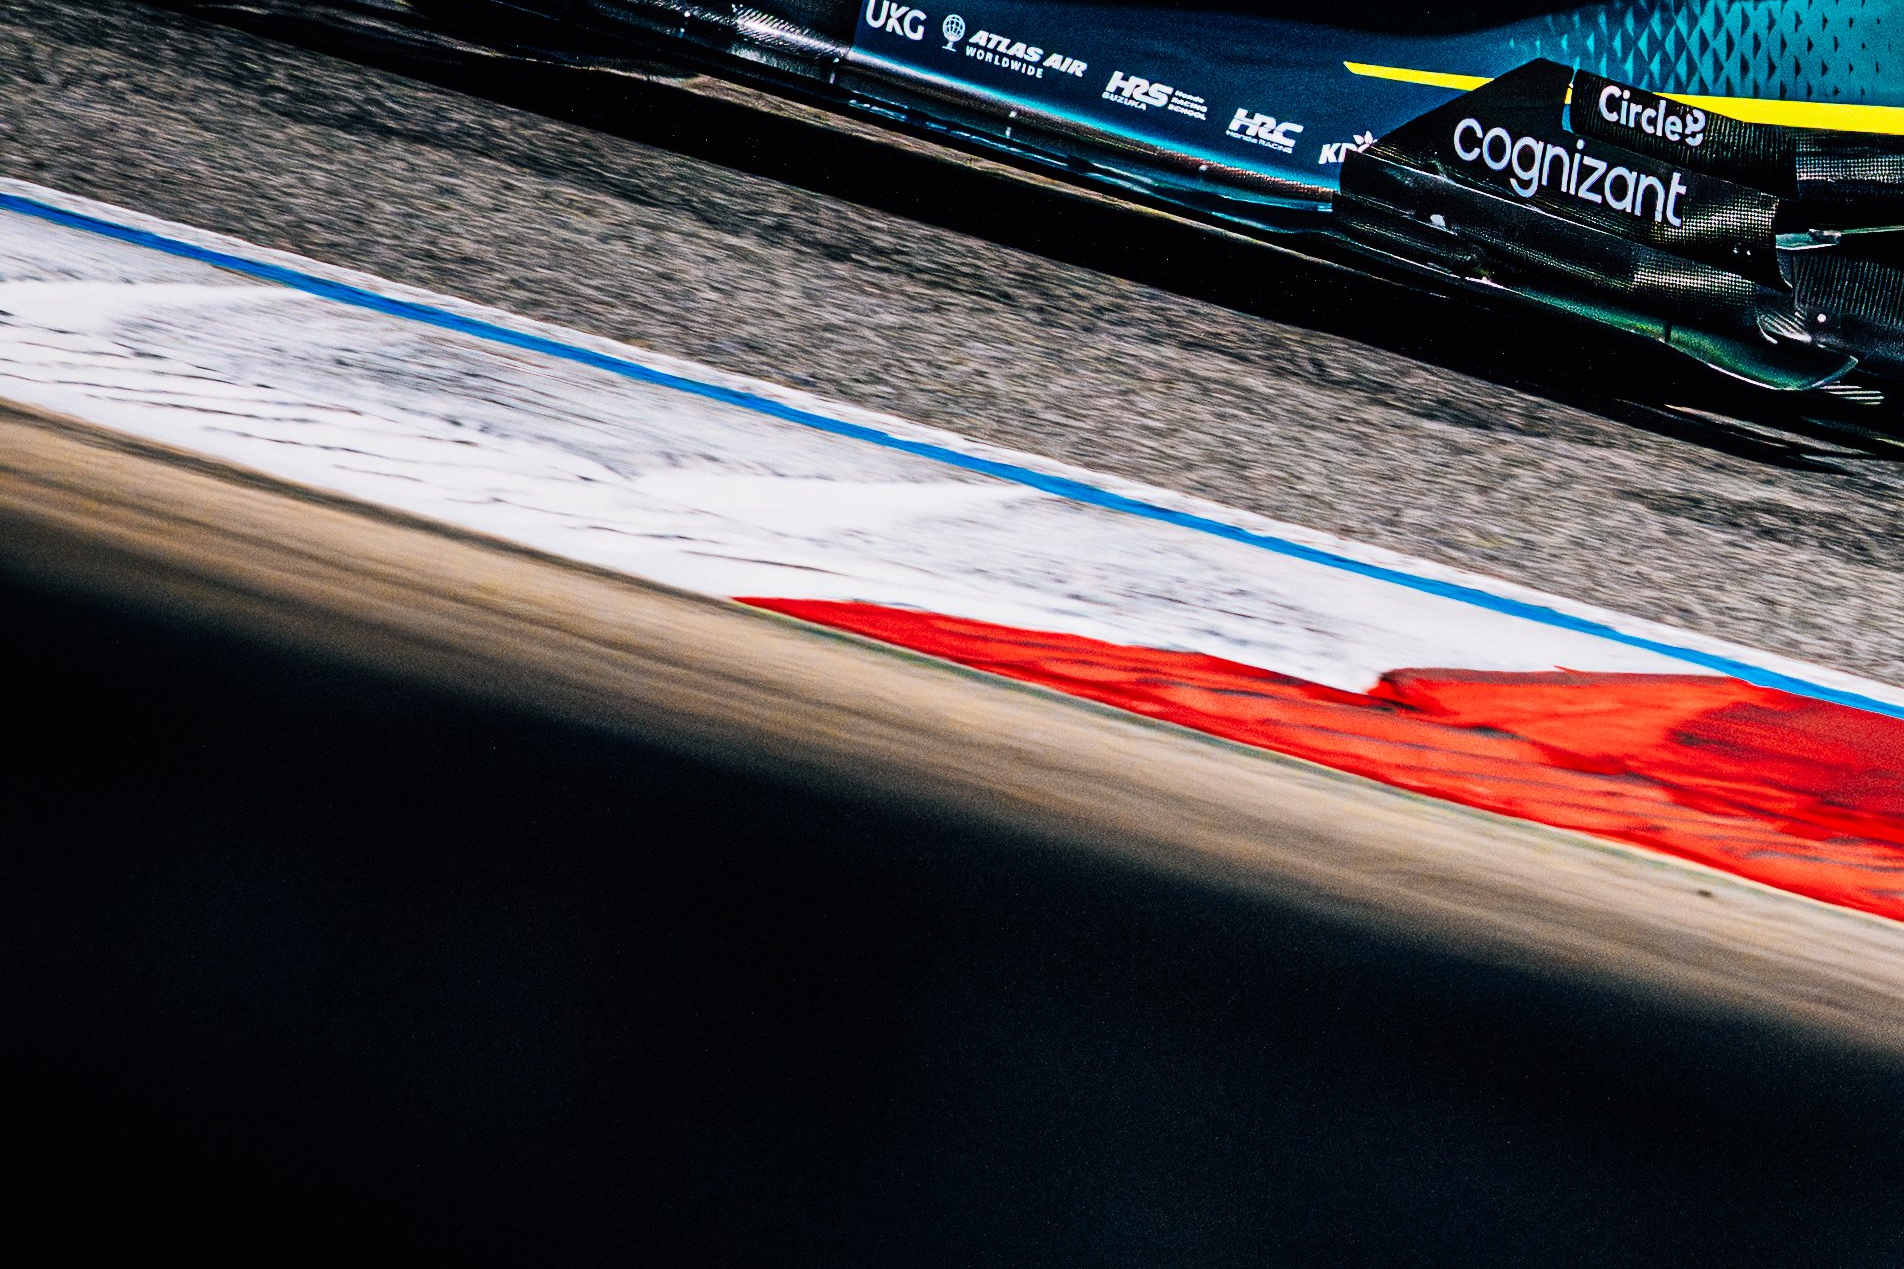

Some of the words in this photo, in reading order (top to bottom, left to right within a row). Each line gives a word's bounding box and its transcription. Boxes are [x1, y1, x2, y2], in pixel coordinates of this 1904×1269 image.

[965, 45, 1044, 79] WORLDWIDE
[969, 29, 1044, 63] ATLAS
[1042, 52, 1088, 78] AIR
[1101, 90, 1147, 111] SUZUKA
[1105, 70, 1174, 108] HRS
[1453, 117, 1687, 227] cognizant
